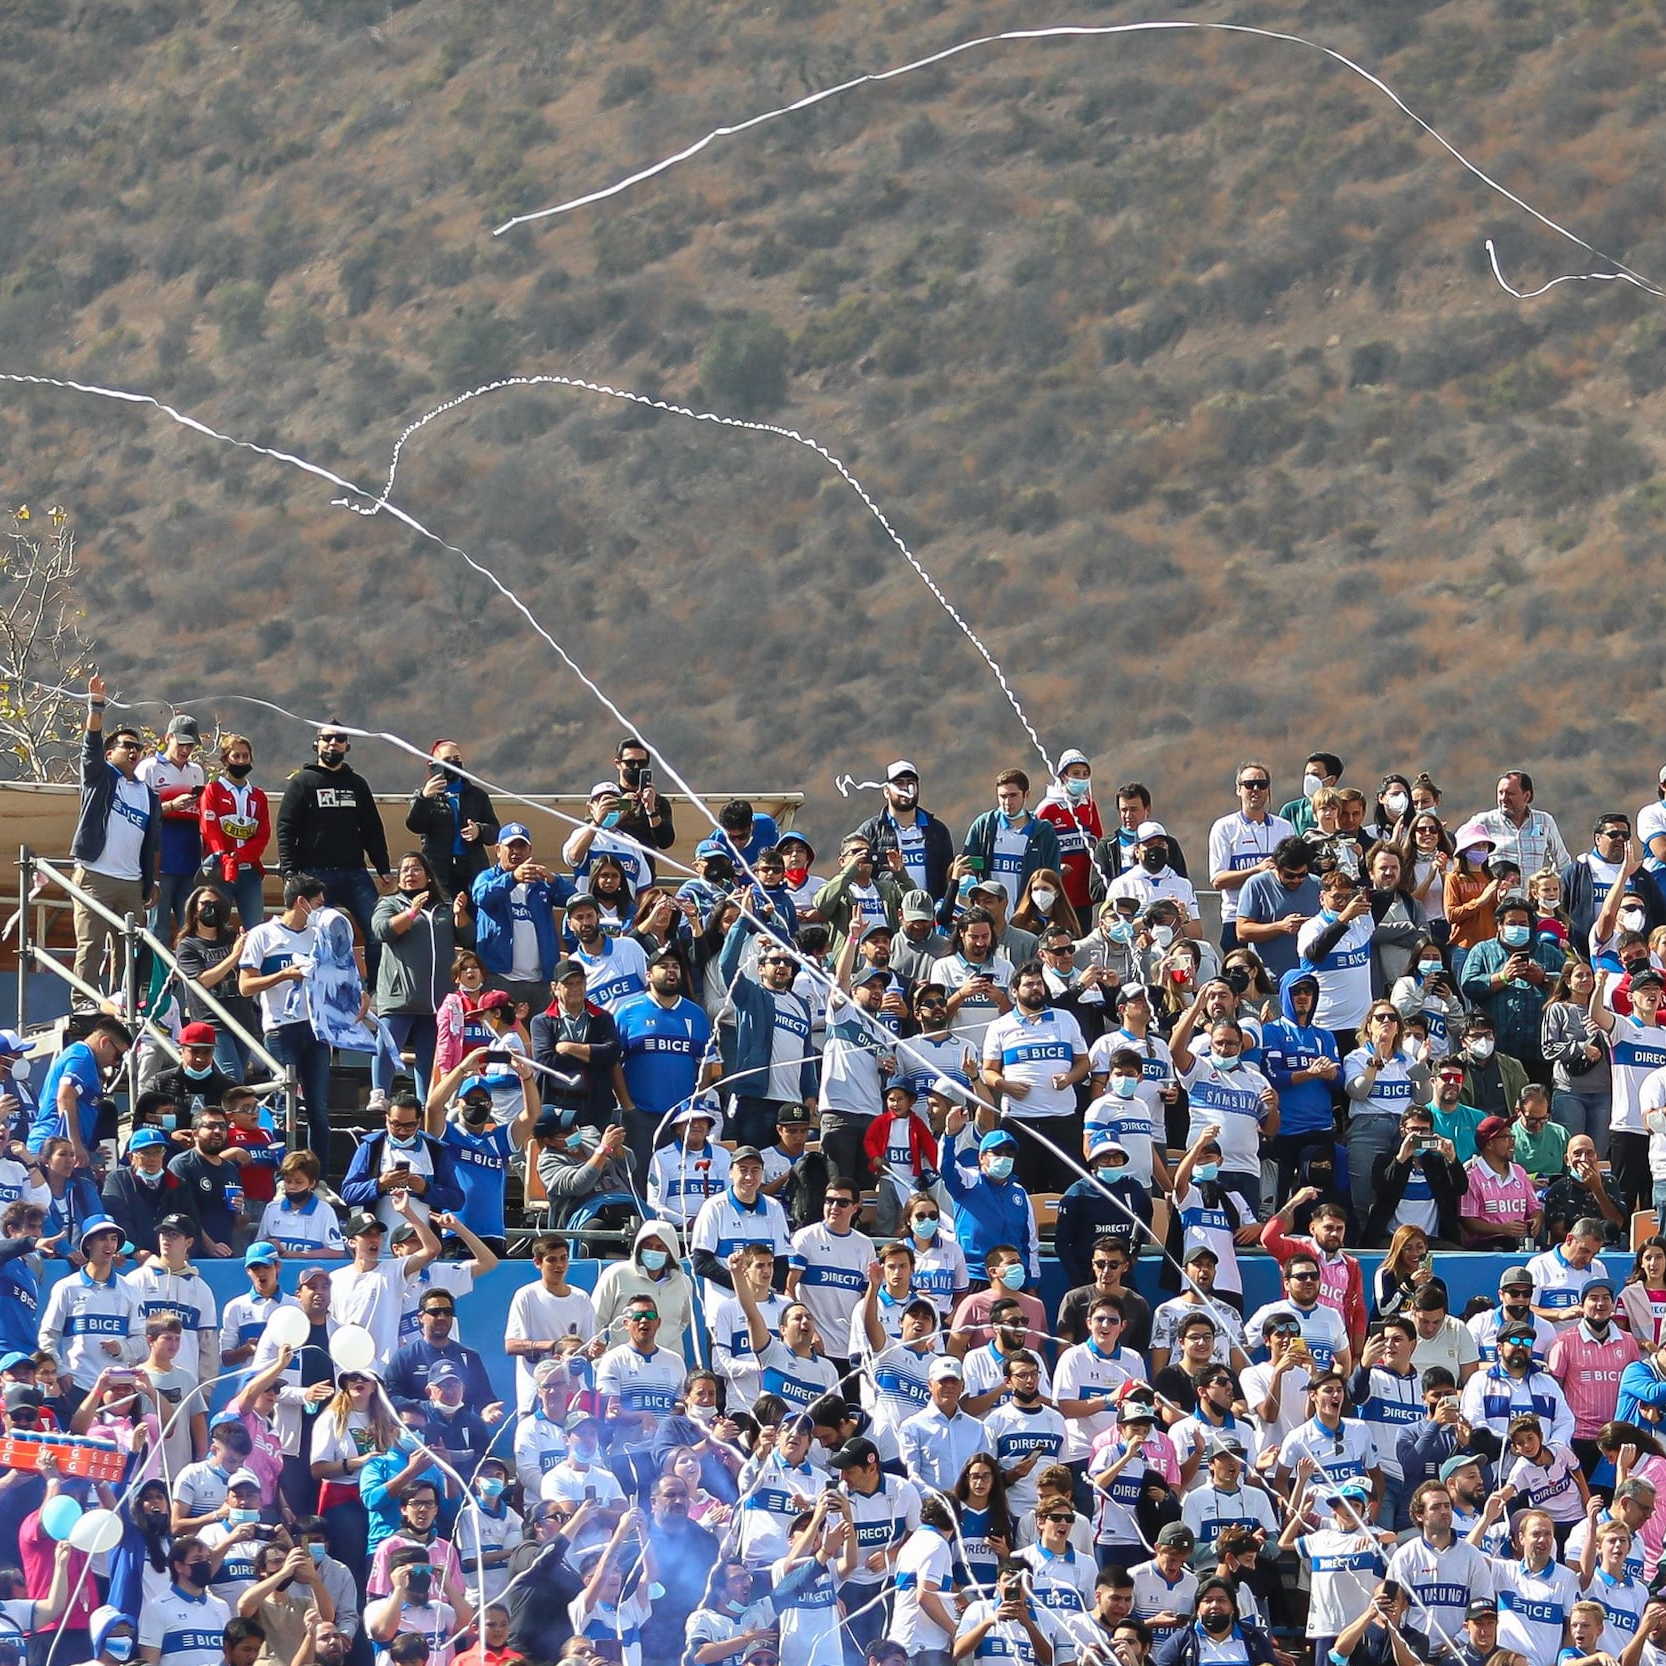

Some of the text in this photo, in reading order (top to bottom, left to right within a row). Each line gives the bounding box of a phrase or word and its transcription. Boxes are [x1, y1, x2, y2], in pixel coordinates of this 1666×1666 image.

[903, 852, 923, 862] BIC
[1002, 860, 1022, 871] BIC
[1348, 953, 1366, 964] BICE
[599, 982, 630, 999] BICE
[658, 1038, 689, 1052] BICE
[1032, 1048, 1064, 1060] BICE
[1383, 1084, 1409, 1096] BICE
[890, 1149, 911, 1159] BIC
[474, 1153, 501, 1168] BICE
[1499, 1200, 1526, 1213] BICE
[820, 1270, 862, 1286] DIRECTV
[88, 1319, 119, 1331] BICE
[909, 1385, 930, 1400] BIC
[645, 1397, 669, 1409] BICE
[1009, 1437, 1057, 1452] DIRECTV
